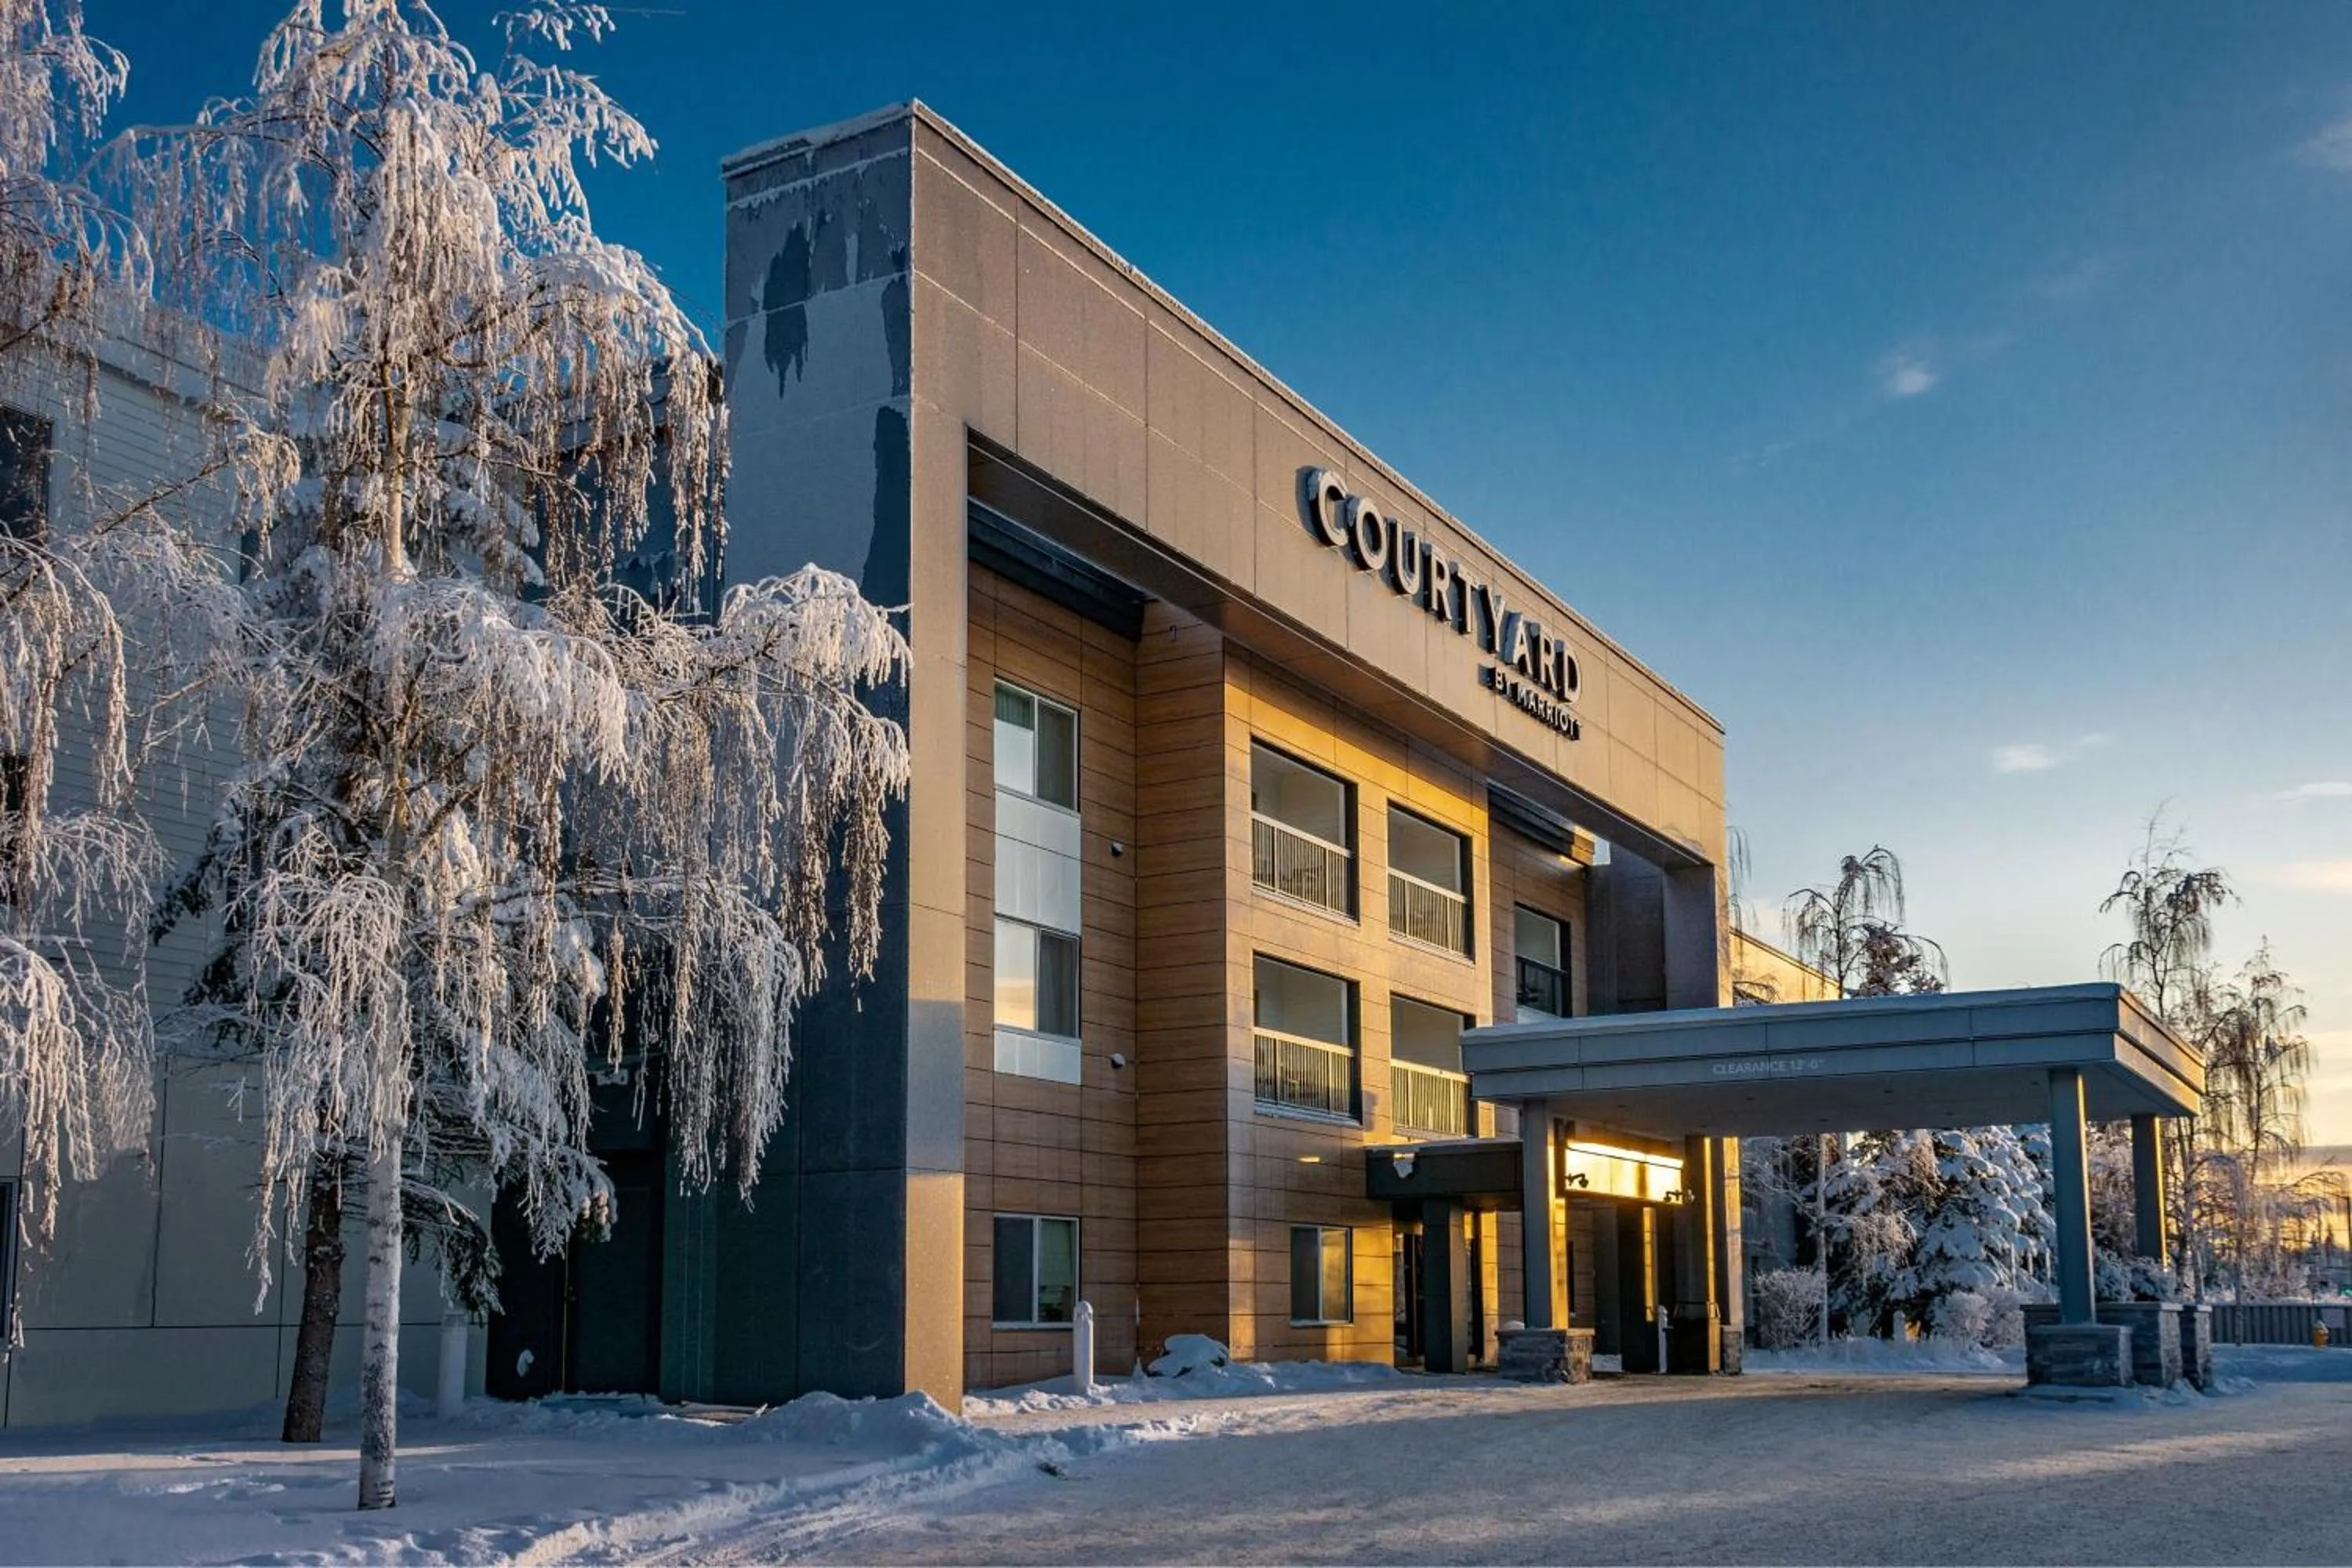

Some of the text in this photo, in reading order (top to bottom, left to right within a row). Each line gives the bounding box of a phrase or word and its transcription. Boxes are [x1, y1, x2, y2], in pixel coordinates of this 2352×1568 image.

[1311, 468, 1583, 706] COURTYARD
[1493, 666, 1581, 741] BY MARRIOTT
[1712, 1060, 1788, 1075] CLEARANCE
